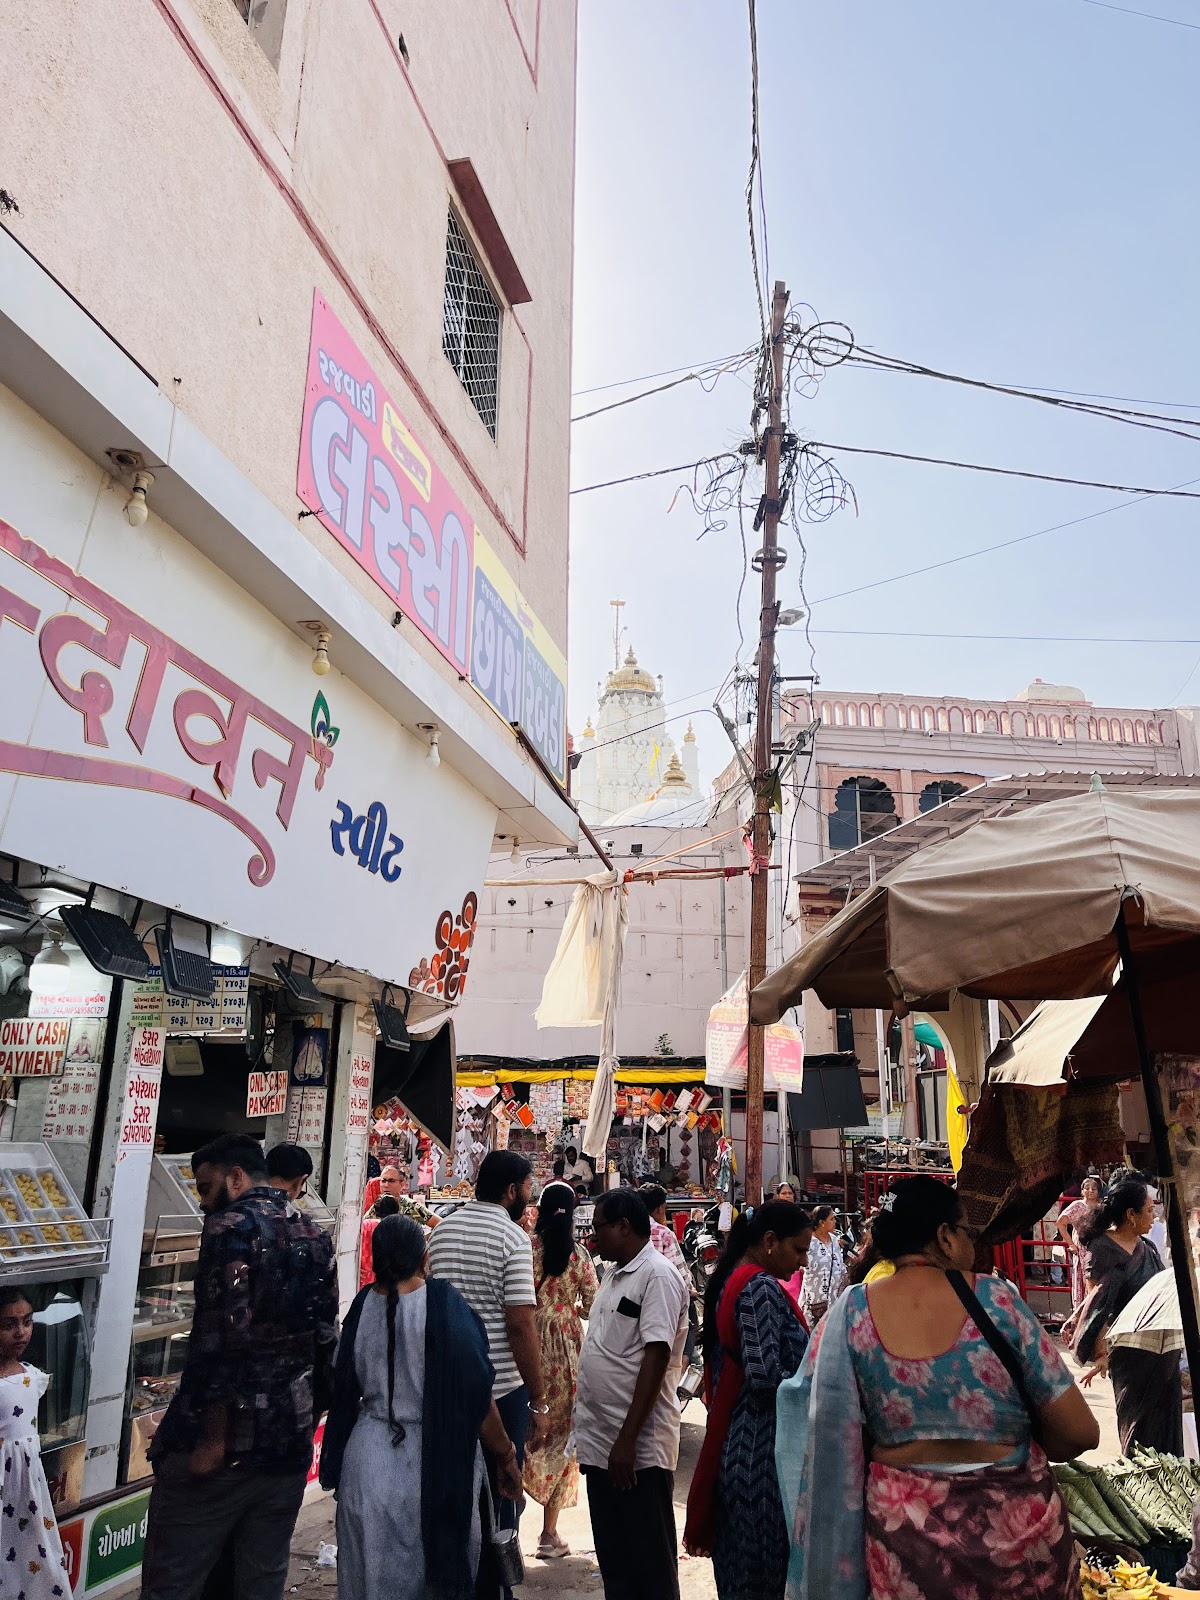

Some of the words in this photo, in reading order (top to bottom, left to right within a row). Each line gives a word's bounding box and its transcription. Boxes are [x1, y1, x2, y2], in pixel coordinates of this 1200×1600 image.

[318, 348, 377, 424] રજવાડી
[310, 396, 469, 667] લસ્સી
[329, 799, 404, 883] સ્વીટ
[2, 1022, 34, 1046] ONLY
[36, 1022, 68, 1045] CASH
[248, 1094, 286, 1116] PAYMENT
[249, 1072, 268, 1093] ONLY
[269, 1071, 287, 1091] CASH
